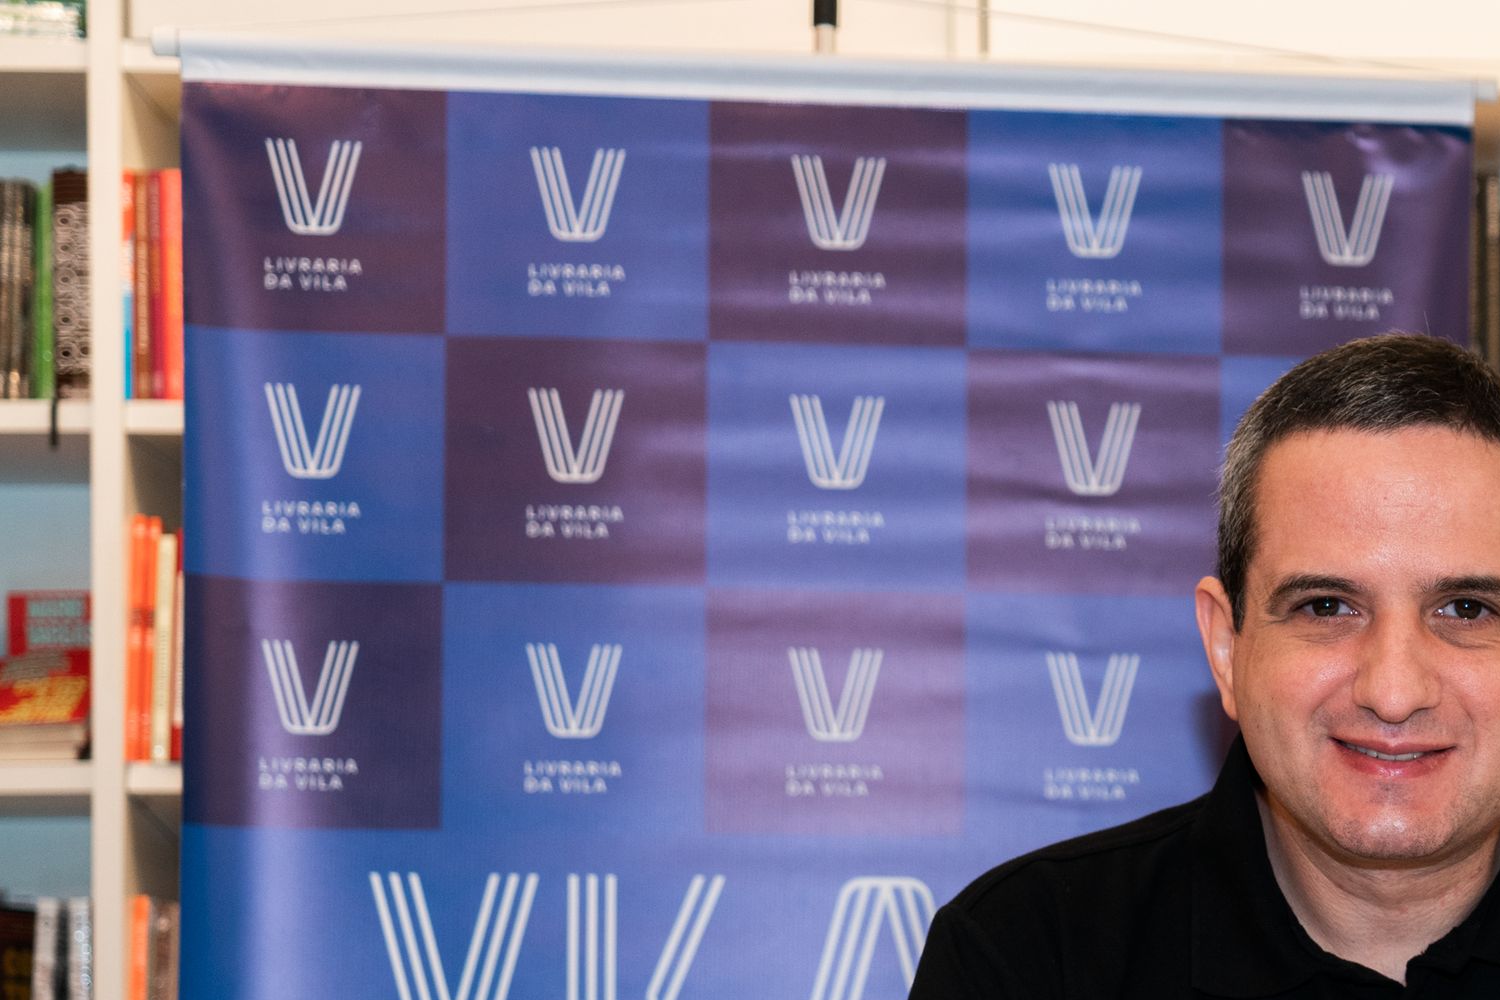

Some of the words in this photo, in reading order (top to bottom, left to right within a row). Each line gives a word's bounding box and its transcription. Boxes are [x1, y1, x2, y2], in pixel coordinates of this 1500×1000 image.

[264, 257, 361, 274] LIVRARIA
[528, 263, 625, 281] LIVRARIA
[264, 273, 293, 291] DA
[300, 273, 348, 291] VILA
[528, 280, 557, 298] DA
[564, 280, 611, 298] VILA
[789, 270, 885, 290] LIVRARIA
[1047, 278, 1142, 297] LIVRARIA
[788, 289, 818, 306] DA
[823, 289, 873, 306] VILA
[1300, 286, 1393, 304] LIVRARIA
[1047, 296, 1076, 313] DA
[1081, 296, 1129, 313] VILA
[1300, 303, 1329, 321] DA
[1335, 303, 1380, 321] VILA
[262, 500, 360, 518] LIVRARIA
[525, 504, 623, 522] LIVRARIA
[262, 517, 291, 535] DA
[298, 517, 346, 535] VILA
[526, 521, 556, 539] DA
[561, 521, 609, 539] VILA
[260, 757, 358, 775] LIVRARIA
[523, 760, 621, 777] LIVRARIA
[259, 774, 288, 791] DA
[295, 774, 344, 791] VILA
[524, 776, 554, 795] DA
[560, 776, 607, 795] VILA
